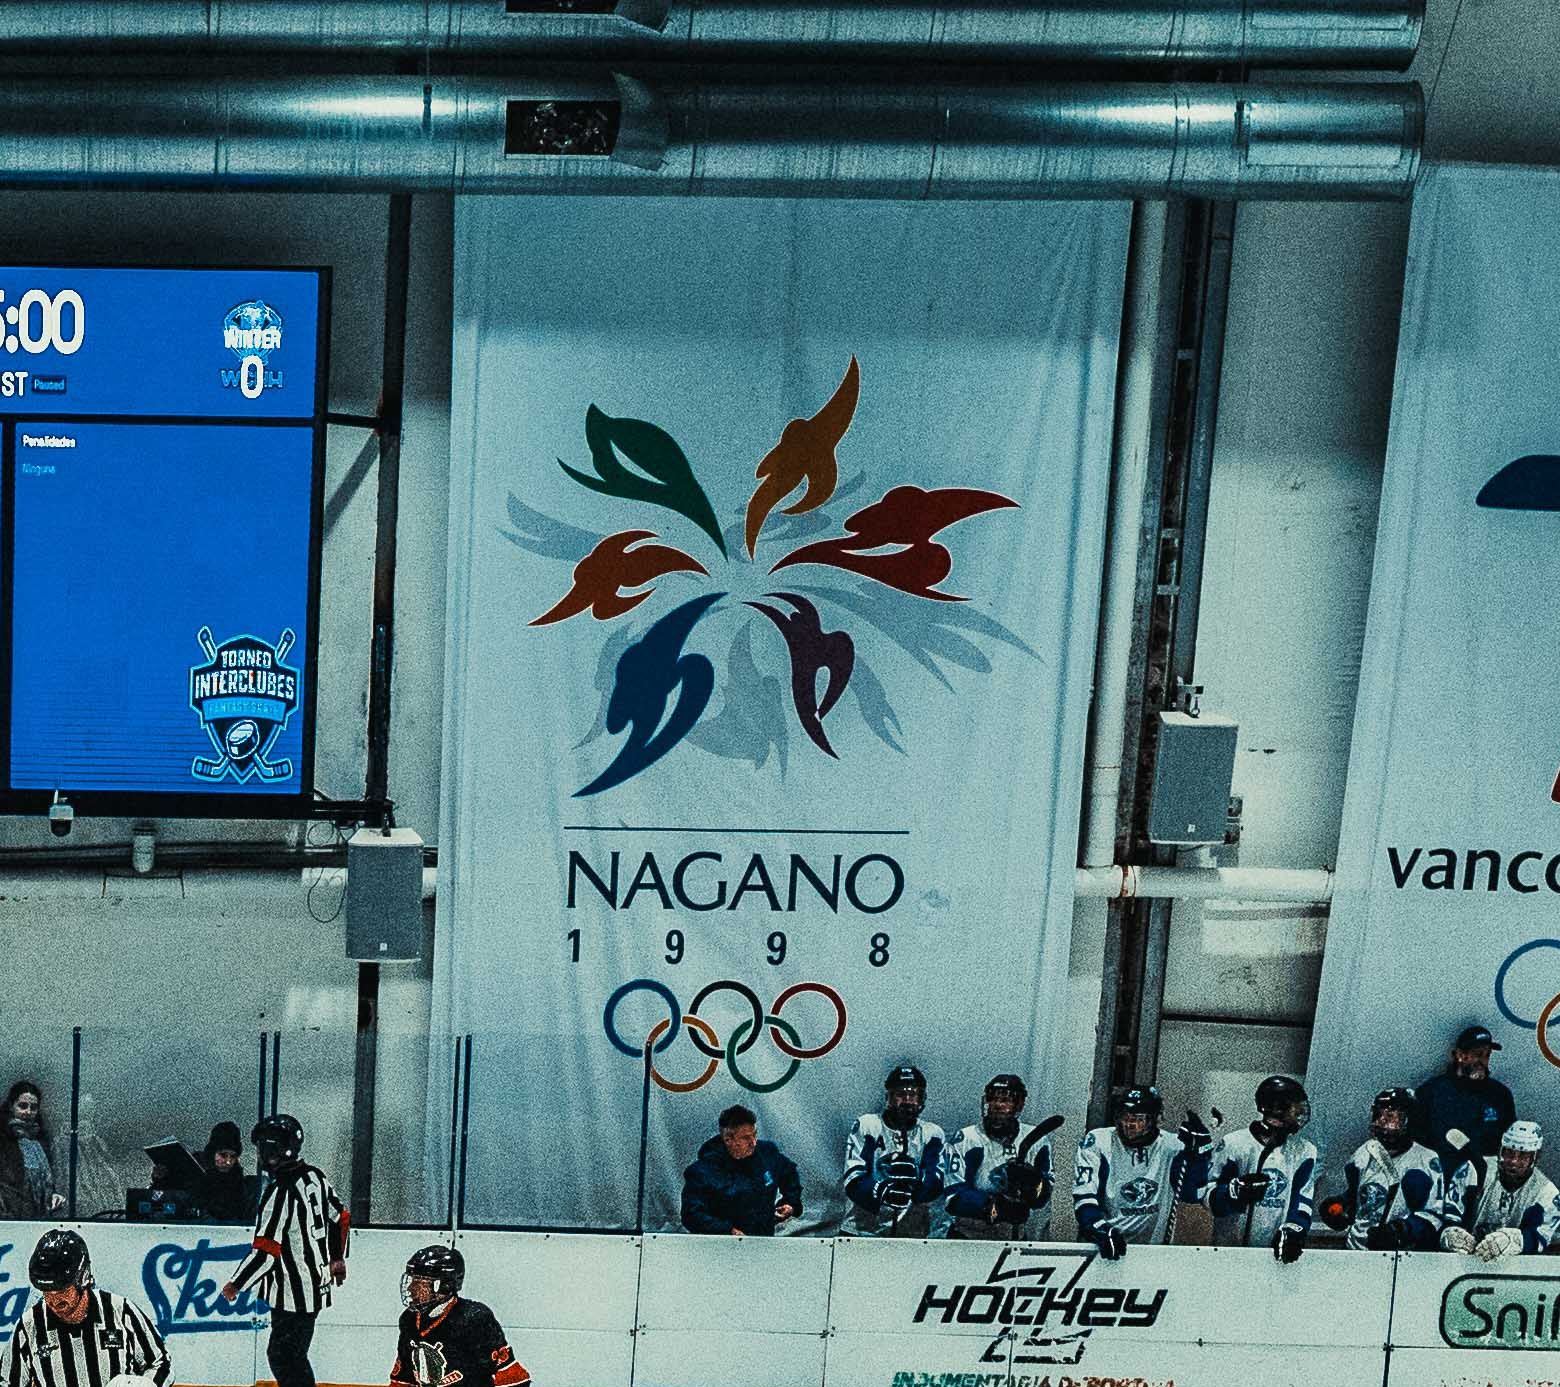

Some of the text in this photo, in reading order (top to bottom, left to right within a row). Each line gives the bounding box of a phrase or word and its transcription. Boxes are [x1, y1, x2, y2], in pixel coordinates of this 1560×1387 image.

[241, 355, 264, 398] 0
[221, 649, 272, 669] TORNEO
[195, 669, 295, 700] INTERCLUBES
[566, 850, 905, 914] NAGANO
